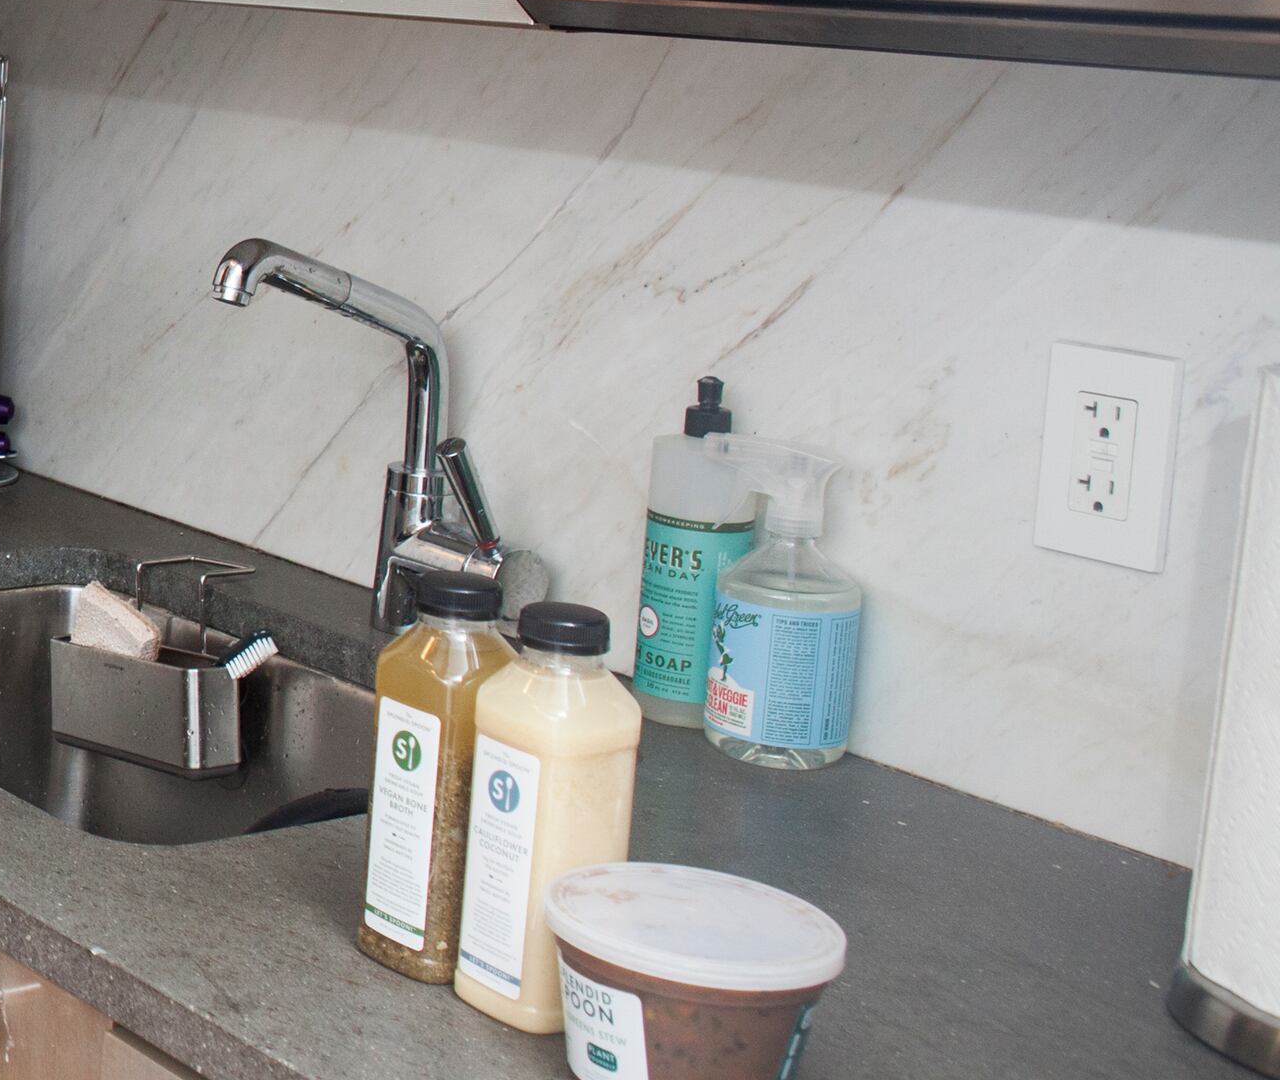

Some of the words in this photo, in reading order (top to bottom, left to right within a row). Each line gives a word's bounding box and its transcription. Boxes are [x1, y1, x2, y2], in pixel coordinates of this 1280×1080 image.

[668, 570, 700, 582] DAY
[724, 604, 759, 629] Green
[645, 651, 692, 672] SOAP
[378, 785, 404, 803] VEGAN
[406, 798, 428, 813] BONE
[389, 800, 414, 816] BROTH
[473, 824, 528, 856] CAULIFLOWER
[479, 838, 520, 862] COCONUT
